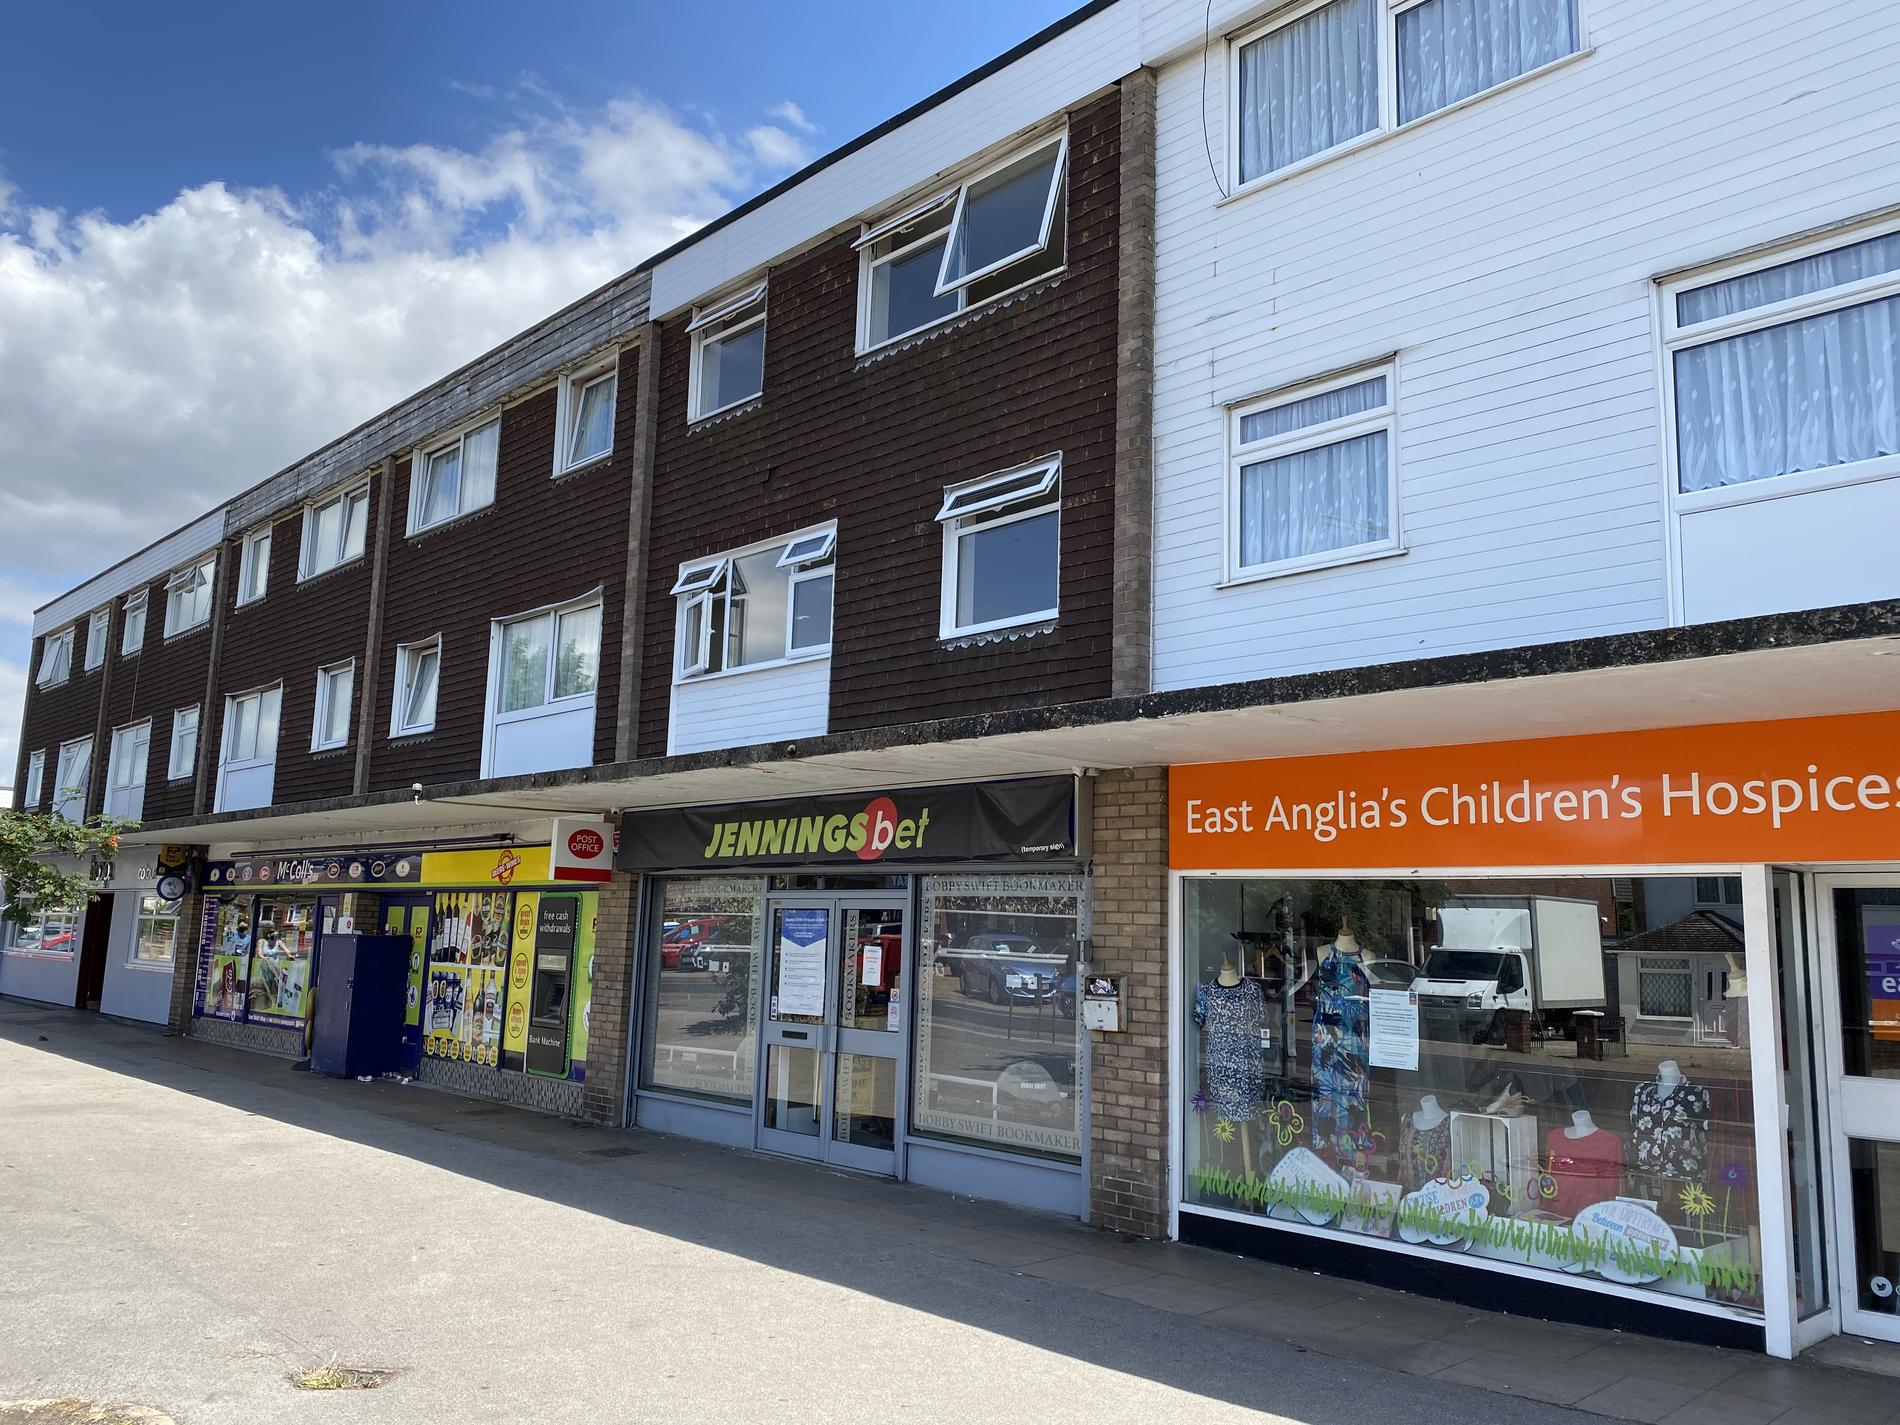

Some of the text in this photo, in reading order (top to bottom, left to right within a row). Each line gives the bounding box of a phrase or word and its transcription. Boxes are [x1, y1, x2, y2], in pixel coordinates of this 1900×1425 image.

[1186, 799, 1254, 834] East
[1264, 787, 1408, 843] Anglia's
[1421, 774, 1643, 827] Children's
[576, 834, 598, 844] POST
[704, 808, 929, 859] JENNINGSbet
[570, 843, 599, 853] OFFICE
[1050, 842, 1065, 851] sign)
[277, 860, 314, 880] McColl's
[925, 880, 963, 892] BOBBY
[964, 880, 1000, 892] SWIFT
[543, 910, 569, 920] free cash
[539, 923, 571, 933] withdrawals
[845, 914, 857, 1020] BOOKMAKERS
[528, 1034, 561, 1047] Bank Machine
[918, 1112, 957, 1129] BOBBY
[959, 1119, 994, 1136] SWIFT
